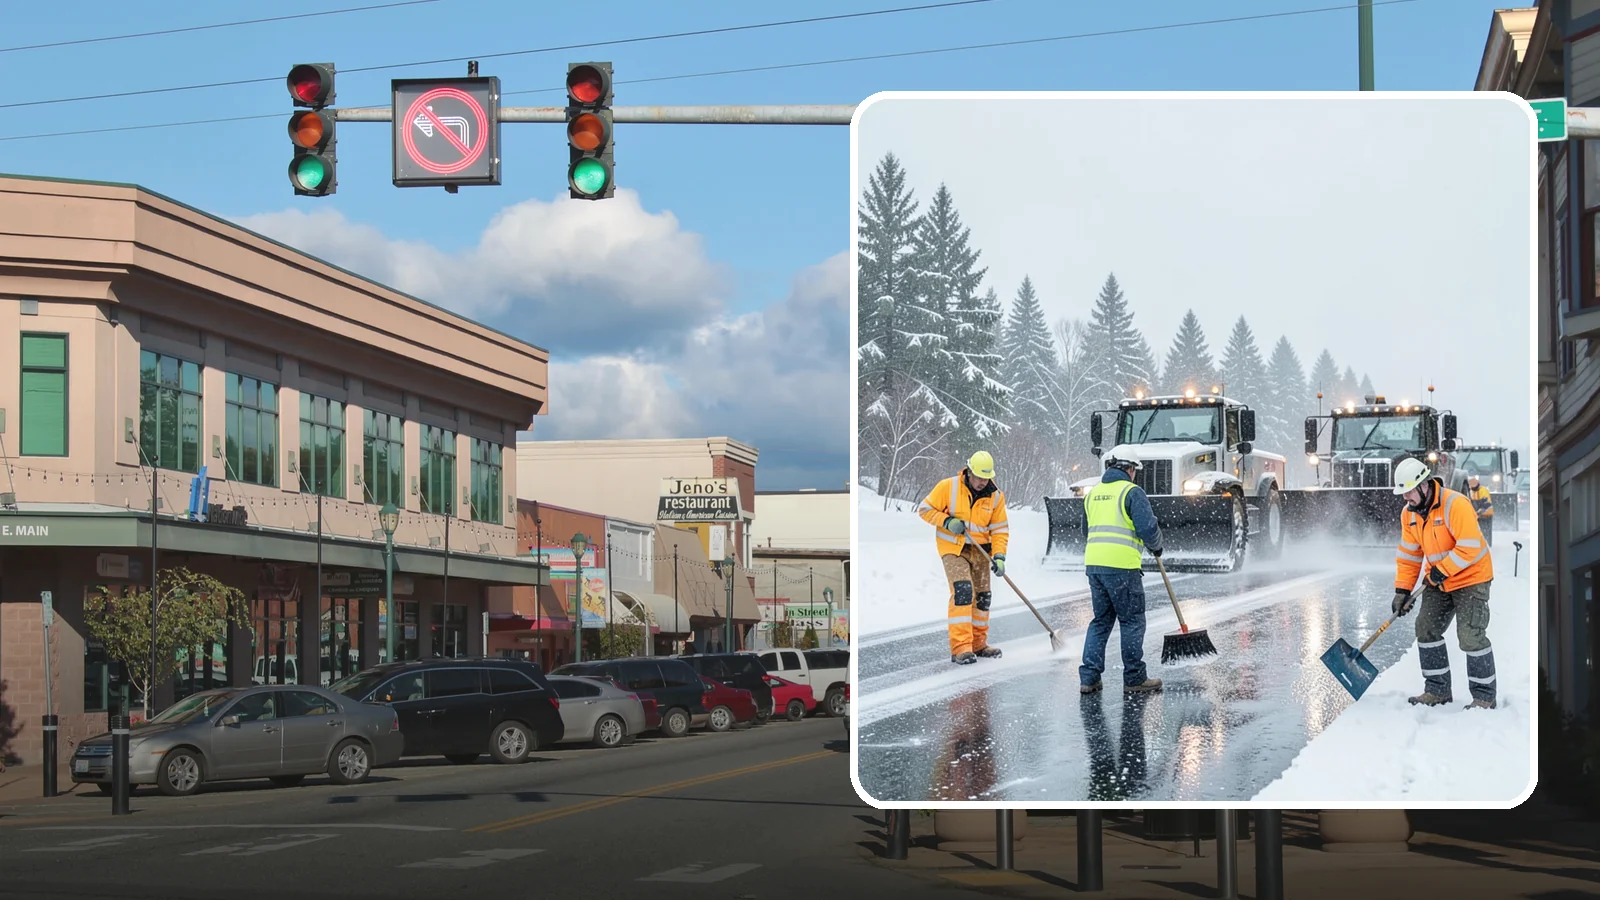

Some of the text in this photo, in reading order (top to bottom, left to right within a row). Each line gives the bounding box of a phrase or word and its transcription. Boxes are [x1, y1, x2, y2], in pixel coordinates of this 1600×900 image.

[669, 480, 728, 494] Jeno's
[665, 496, 731, 509] restaurant
[658, 510, 681, 519] Italian
[686, 509, 714, 519] American
[715, 509, 738, 519] Cuisine
[2, 525, 49, 536] E. MAIN
[798, 608, 828, 616] Street
